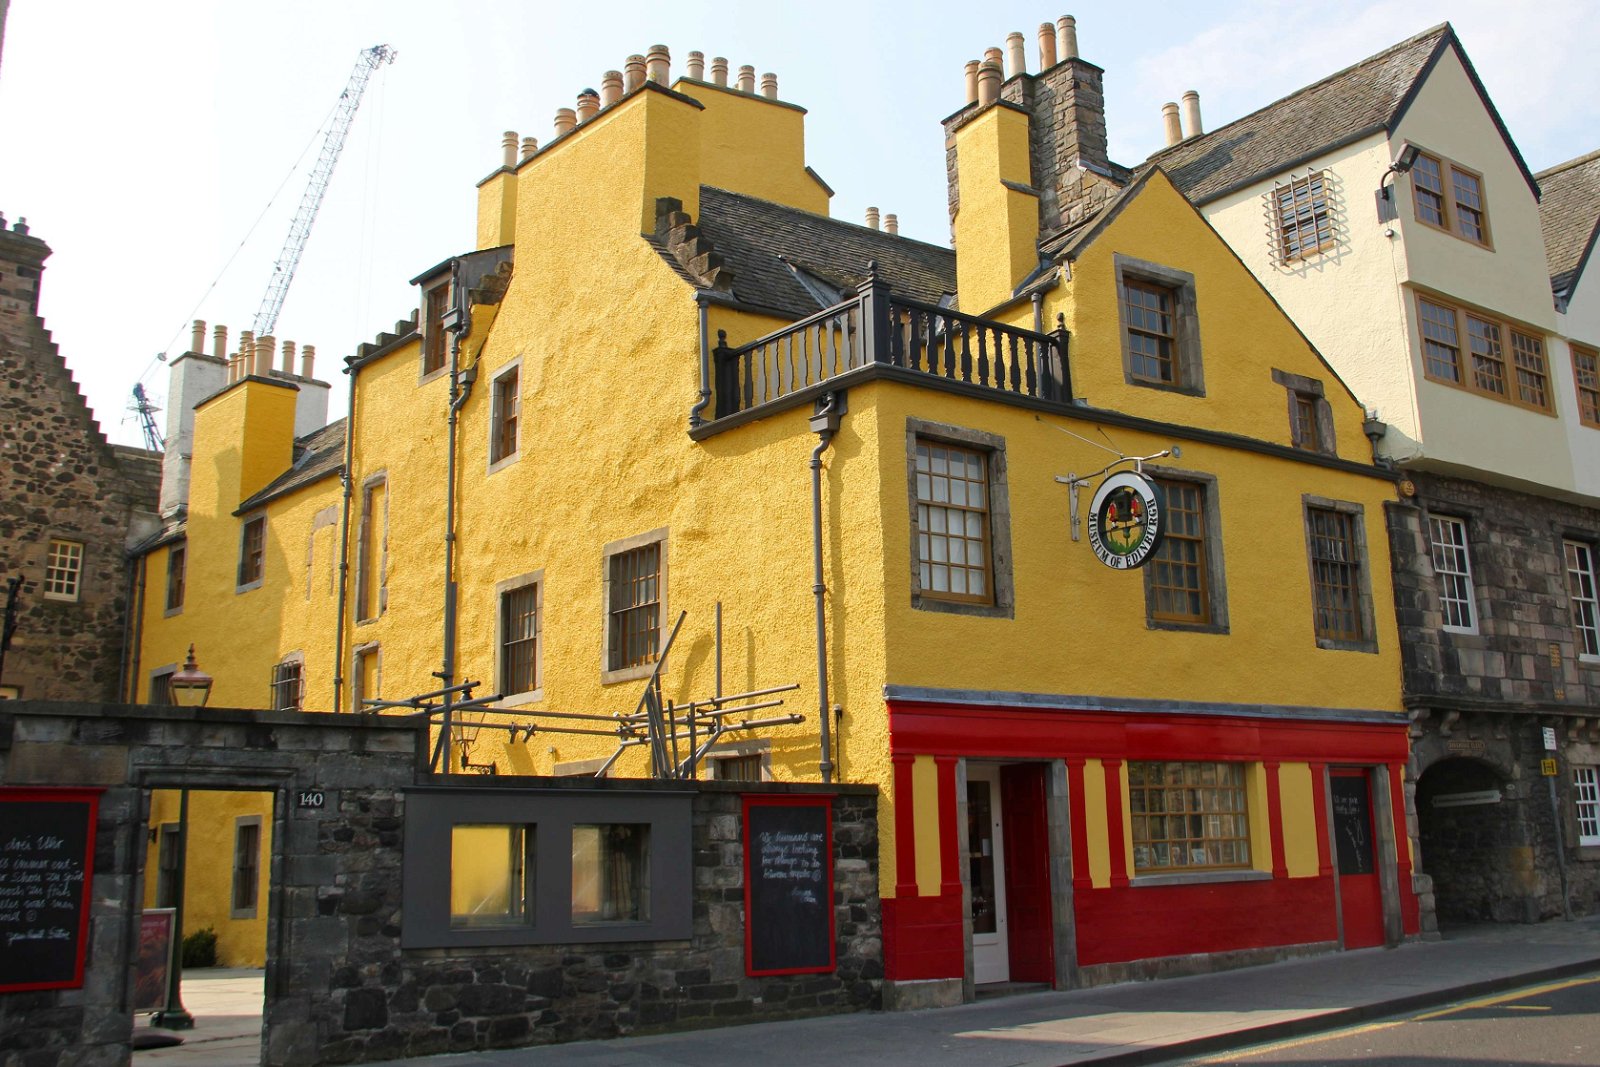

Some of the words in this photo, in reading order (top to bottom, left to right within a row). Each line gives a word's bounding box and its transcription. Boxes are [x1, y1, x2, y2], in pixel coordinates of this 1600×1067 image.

[1089, 512, 1109, 562] MUSEUM
[1110, 557, 1122, 567] OF
[1126, 498, 1158, 567] EDINBURGH
[299, 793, 323, 806] 140
